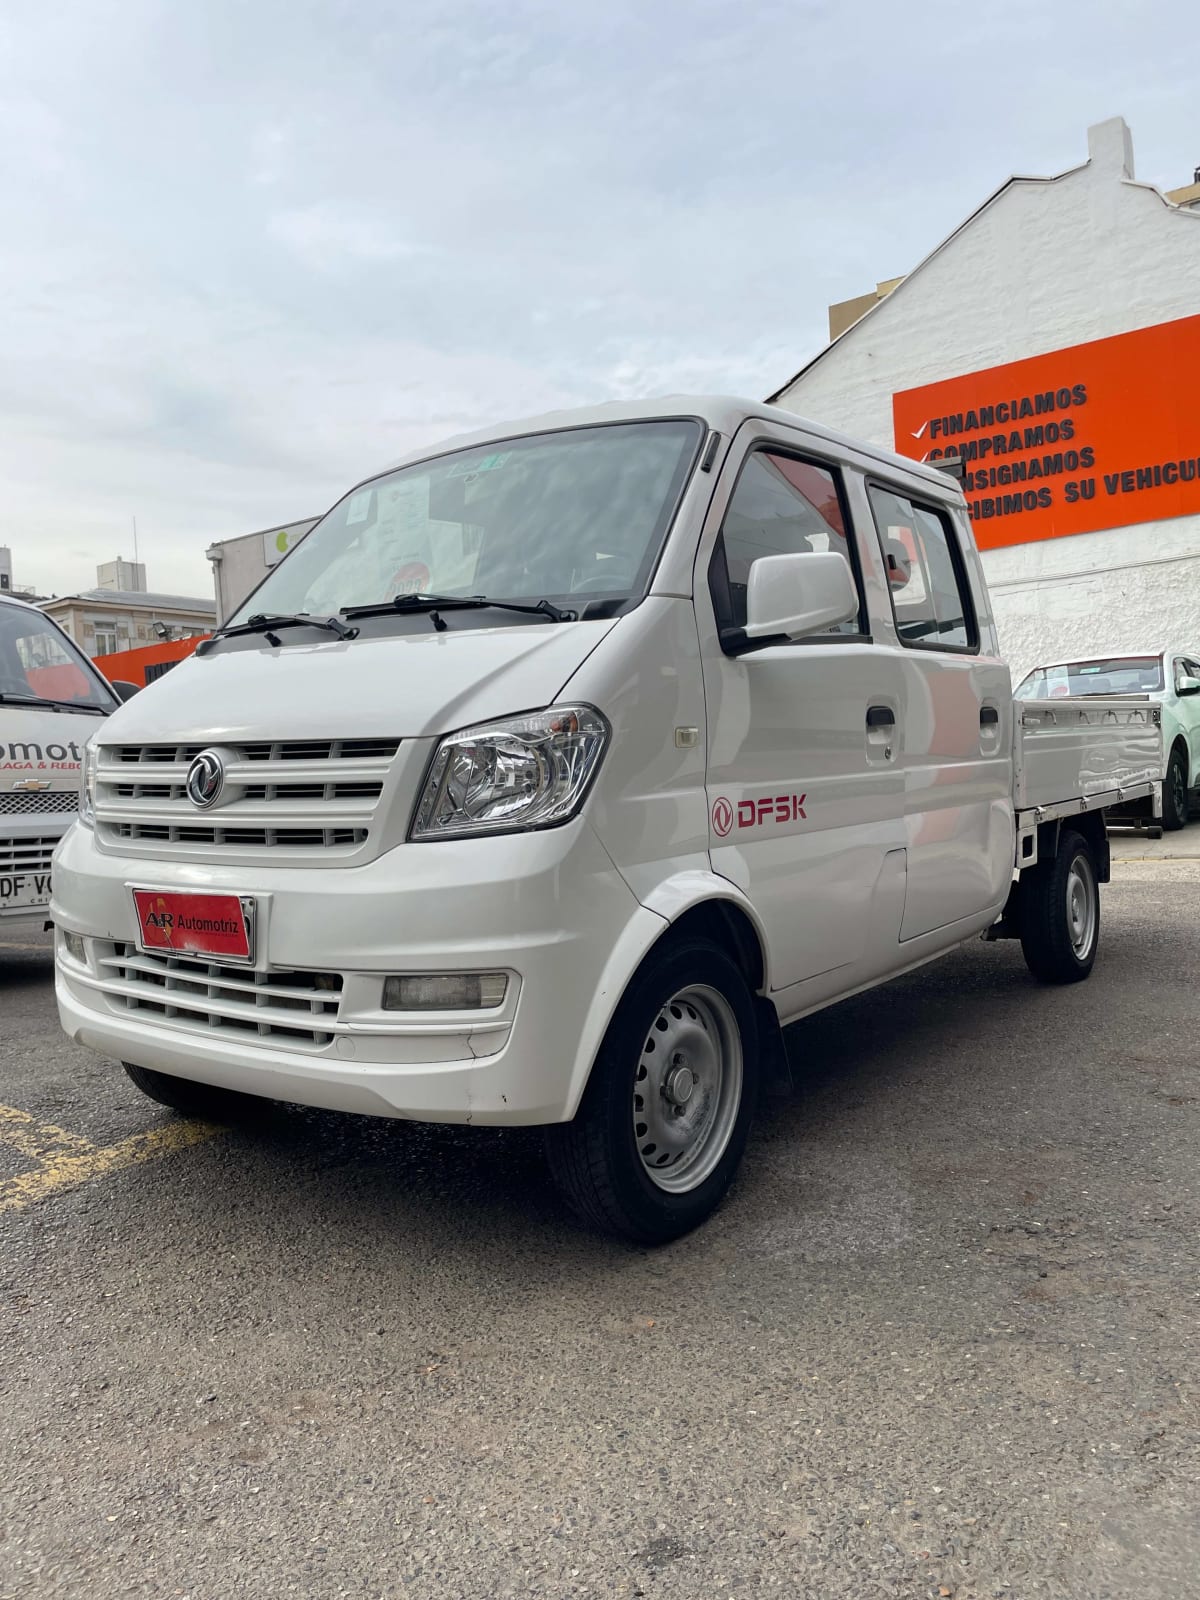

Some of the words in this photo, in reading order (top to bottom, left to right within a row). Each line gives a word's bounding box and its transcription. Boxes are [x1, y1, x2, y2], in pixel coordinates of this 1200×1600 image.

[930, 384, 1087, 438] FINANCIAMOS
[960, 447, 1095, 493] NSIGNAMOS
[967, 487, 1052, 521] IBIMOS
[1065, 478, 1095, 502] SU
[1104, 457, 1200, 494] VEHICU
[738, 794, 807, 828] DFSK
[177, 915, 238, 933] Automotriz
